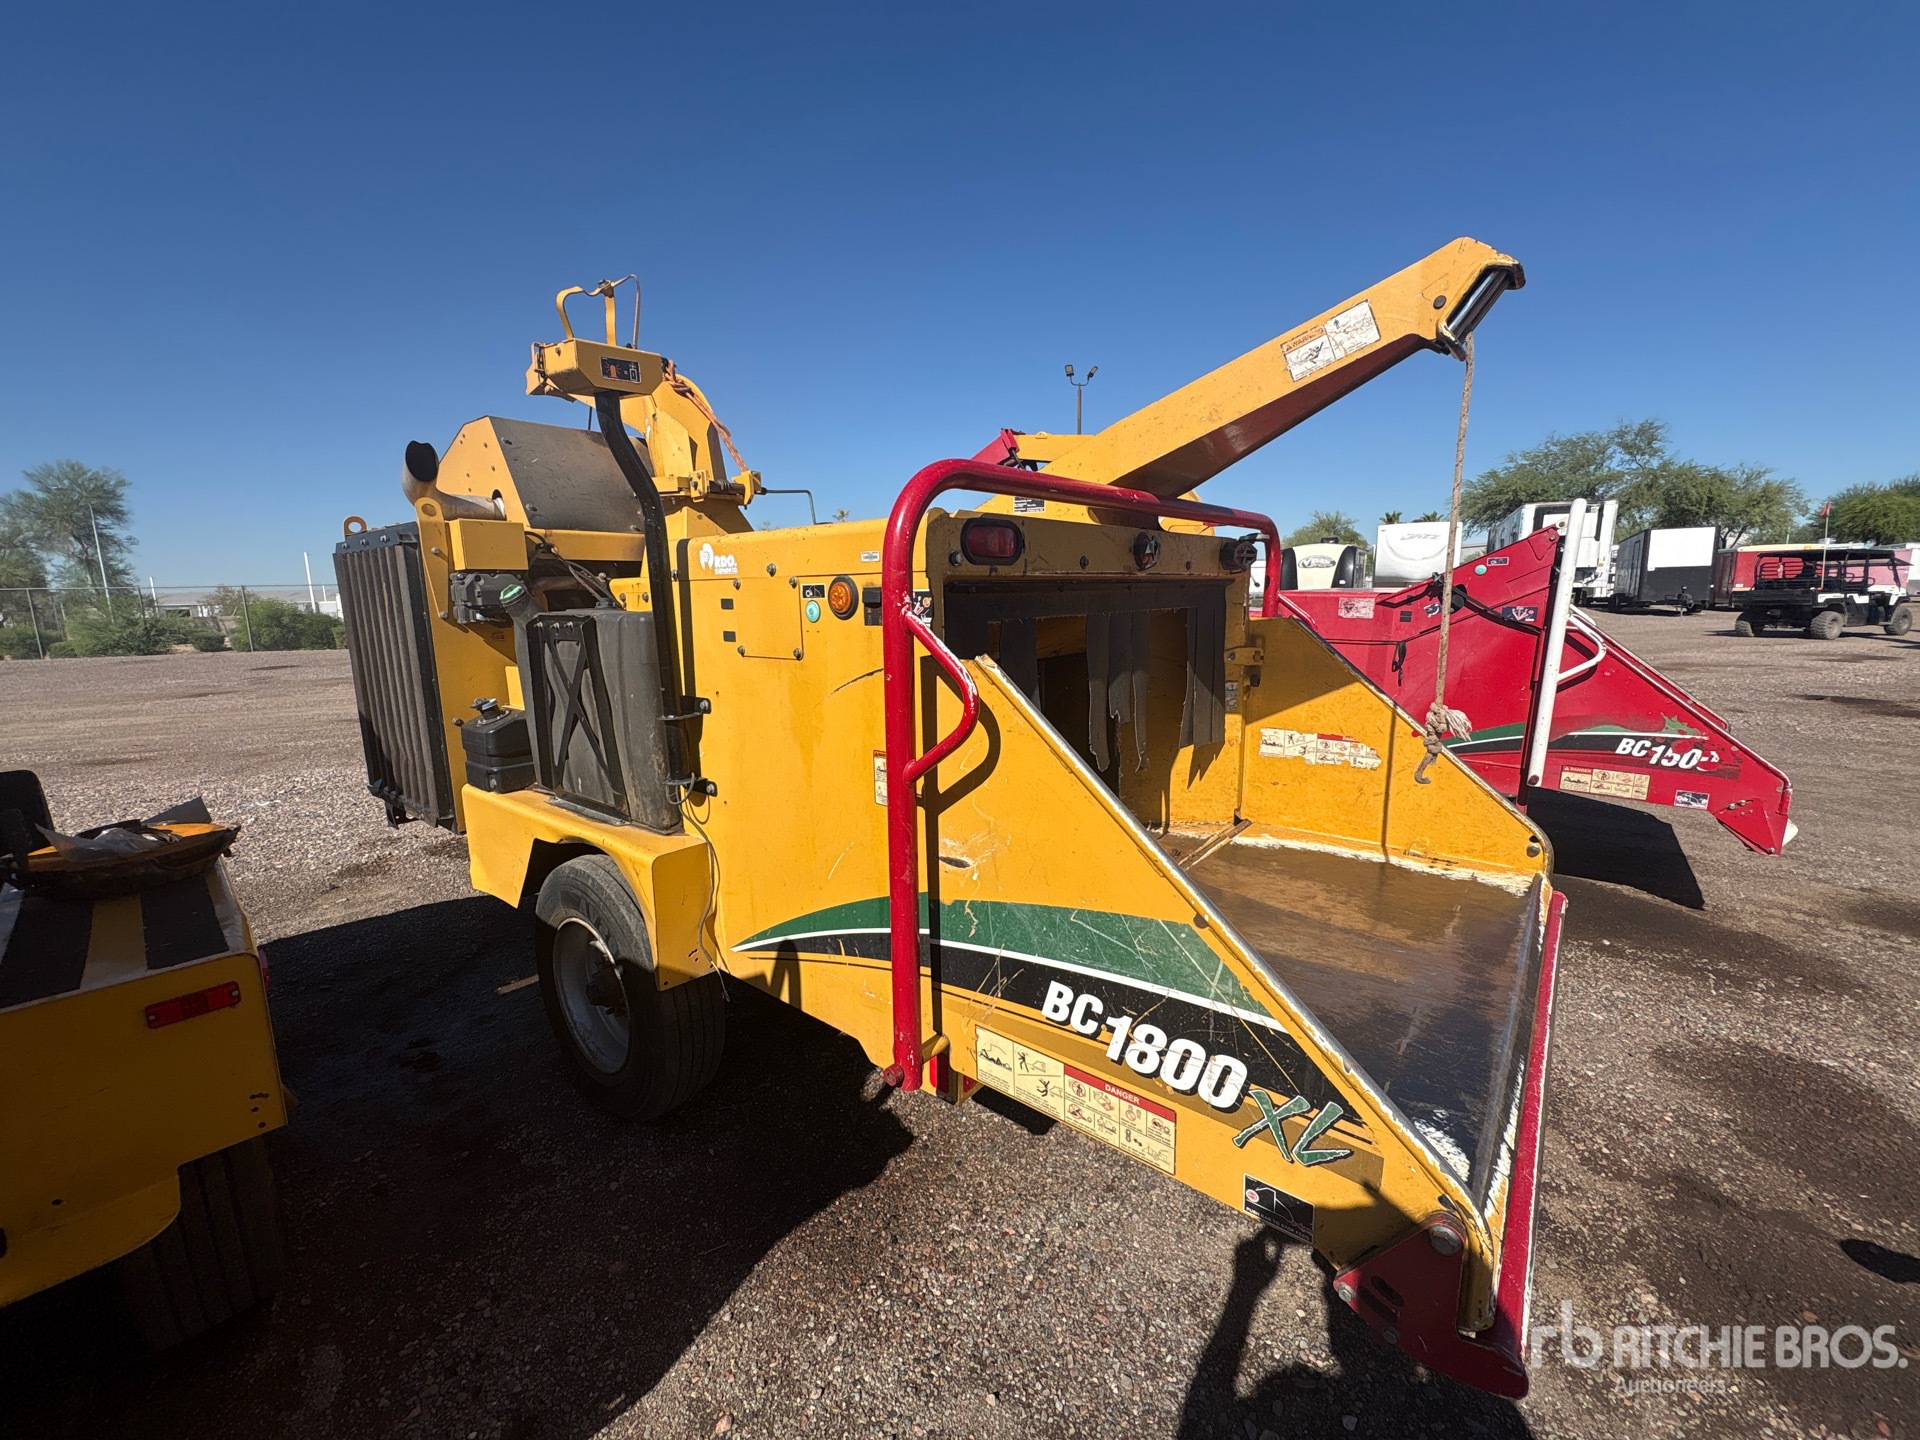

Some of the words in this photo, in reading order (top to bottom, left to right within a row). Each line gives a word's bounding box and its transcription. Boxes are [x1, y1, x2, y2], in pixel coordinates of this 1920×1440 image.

[1041, 980, 1248, 1109] BC1800
[1232, 1090, 1354, 1167] XL
[1104, 1083, 1141, 1106] DANGER
